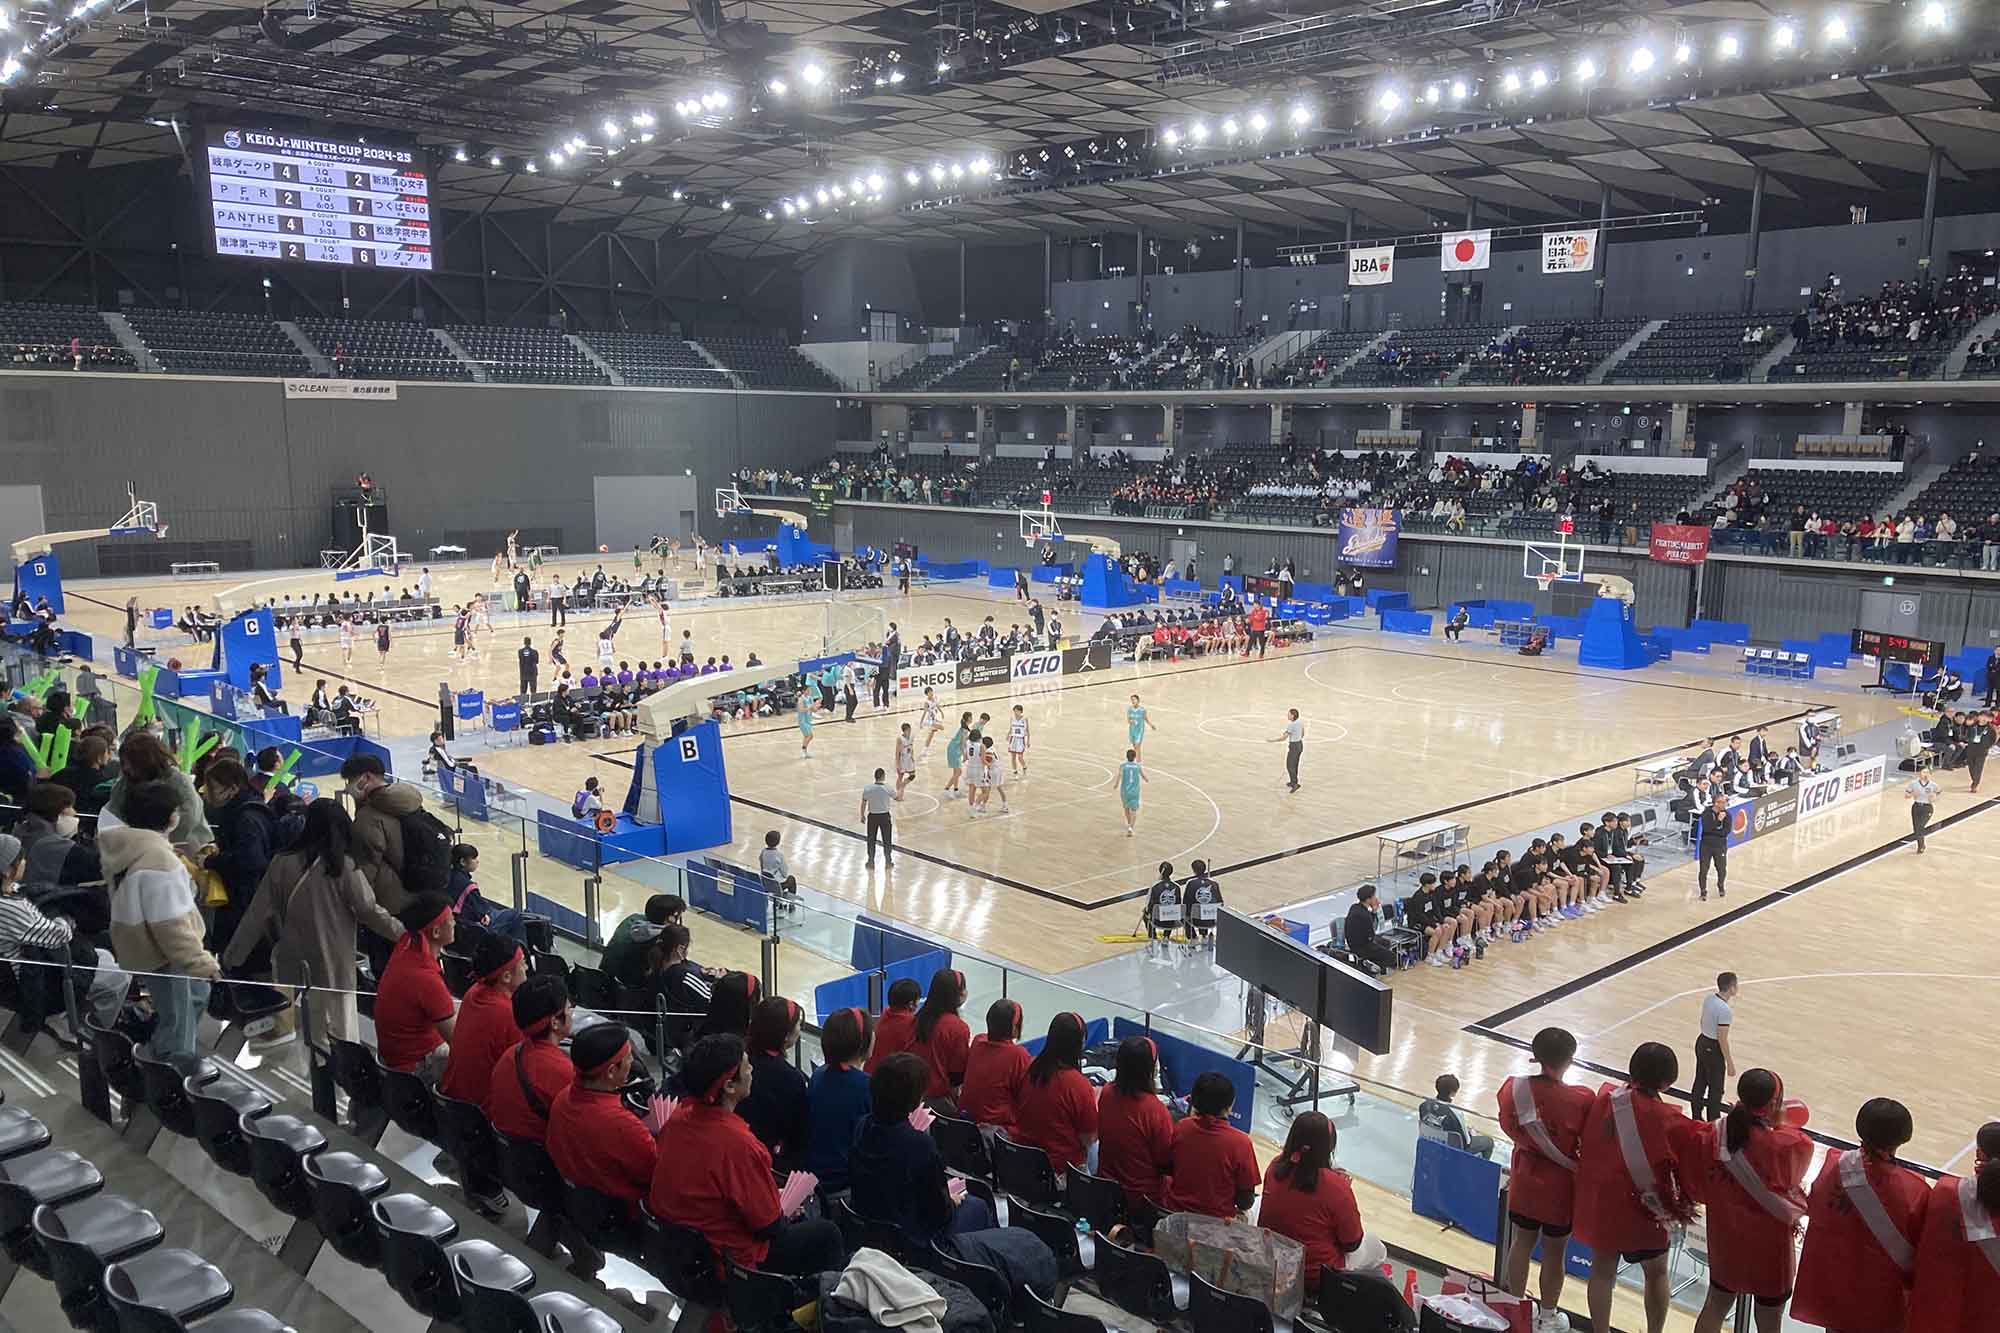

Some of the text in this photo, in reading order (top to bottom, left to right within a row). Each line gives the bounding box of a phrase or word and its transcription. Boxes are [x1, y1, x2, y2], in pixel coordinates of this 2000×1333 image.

[245, 133, 275, 146] KEIO
[338, 144, 362, 156] CUP
[363, 148, 412, 163] 2024-25
[282, 166, 291, 179] 4
[354, 174, 363, 187] 2
[284, 191, 293, 205] 2
[320, 194, 331, 202] 1Q
[356, 200, 364, 212] 7
[218, 210, 275, 225] PANTHE
[286, 218, 296, 231] 4
[358, 225, 367, 237] 8
[288, 244, 297, 257] 2
[323, 245, 335, 253] 1Q
[360, 250, 369, 263] 6
[1352, 258, 1378, 273] JBA
[298, 384, 329, 393] CLEAN
[36, 564, 45, 575] D
[246, 620, 257, 633] C
[1013, 655, 1061, 677] KEIO
[911, 671, 955, 688] ENEOS
[682, 740, 697, 759] B
[1800, 776, 1841, 814] KEIO
